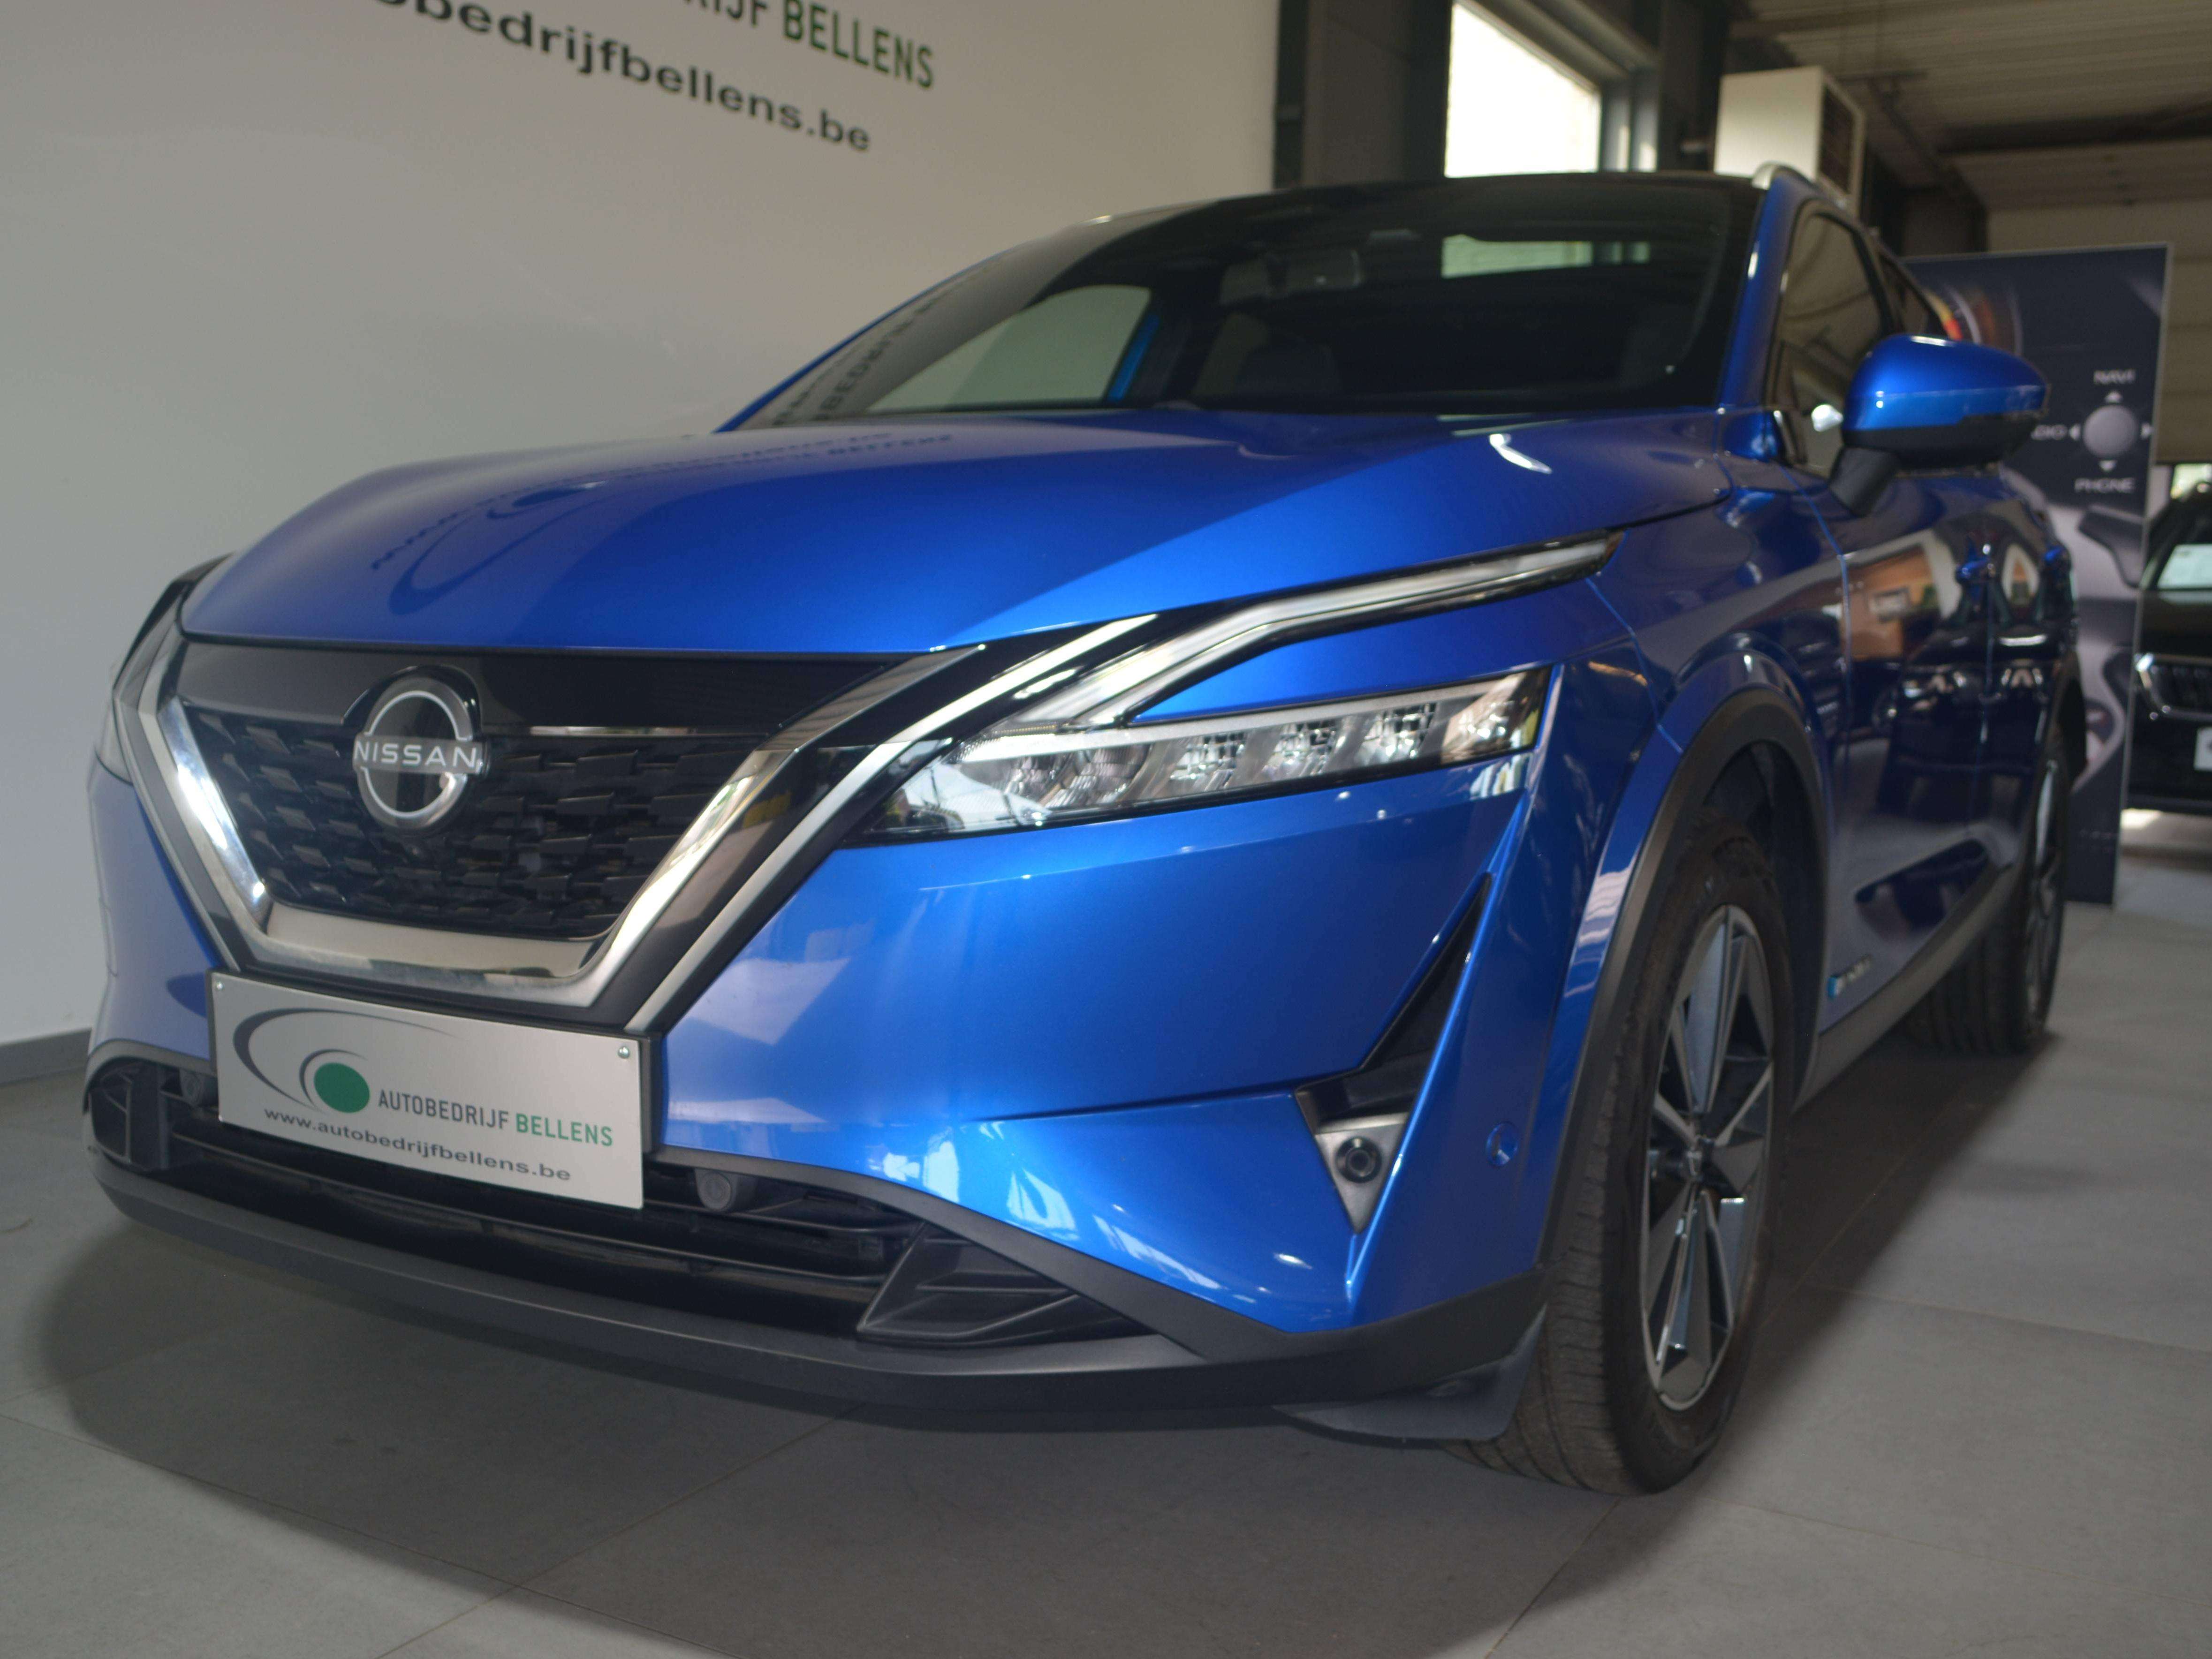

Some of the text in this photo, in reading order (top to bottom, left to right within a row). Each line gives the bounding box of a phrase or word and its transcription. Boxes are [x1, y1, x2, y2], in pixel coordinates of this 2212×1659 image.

[784, 0, 933, 89] BELLENS
[376, 0, 871, 152] bedrijfbellens.be
[2093, 368, 2136, 385] NAVI
[2074, 477, 2135, 494] PHONE
[354, 741, 477, 768] NISSAN
[264, 1109, 571, 1182] www.autobedrijfbellens.be
[379, 1090, 614, 1147] AUTOBEDRIJF BELLENS
